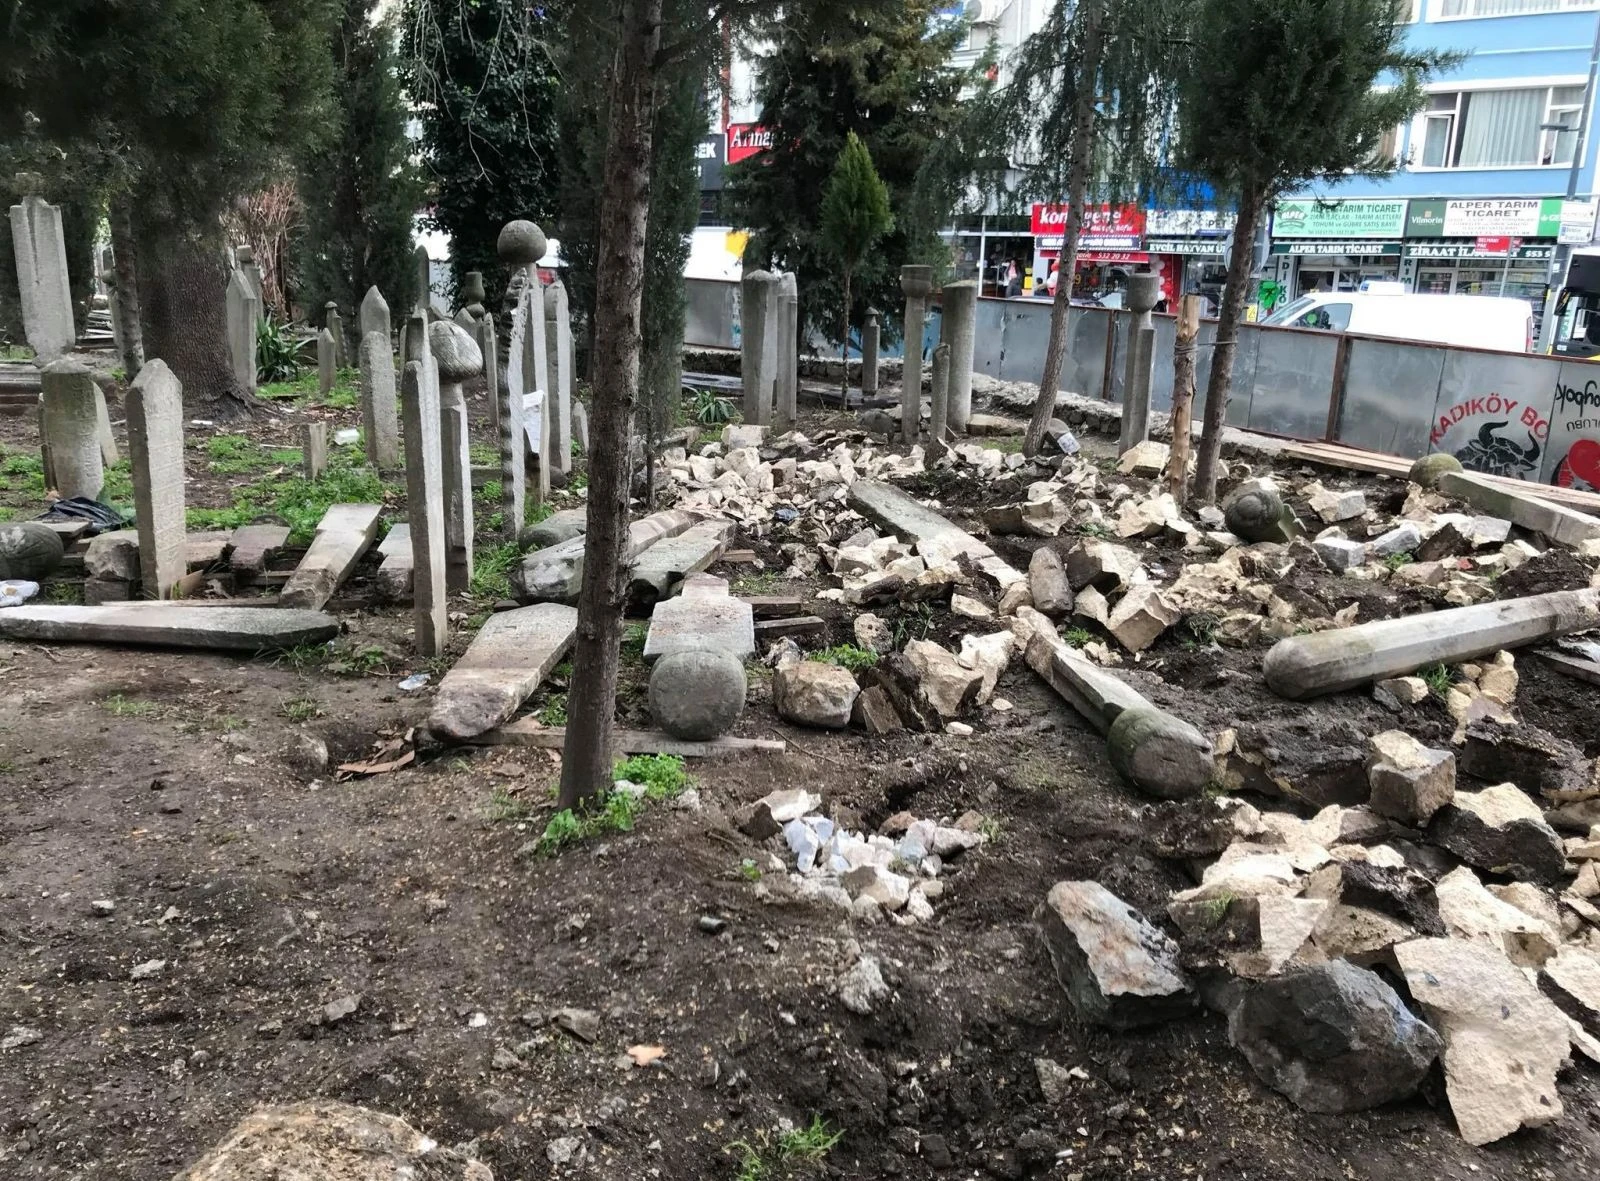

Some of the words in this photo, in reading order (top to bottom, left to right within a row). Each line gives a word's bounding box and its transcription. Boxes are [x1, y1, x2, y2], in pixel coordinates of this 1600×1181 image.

[1339, 204, 1364, 213] TARIM
[1450, 201, 1492, 209] ALPER
[1496, 201, 1538, 209] TARIM
[1412, 216, 1443, 225] Vilmorin
[1289, 245, 1315, 253] ALPER
[1430, 393, 1518, 445] KADIKÖY
